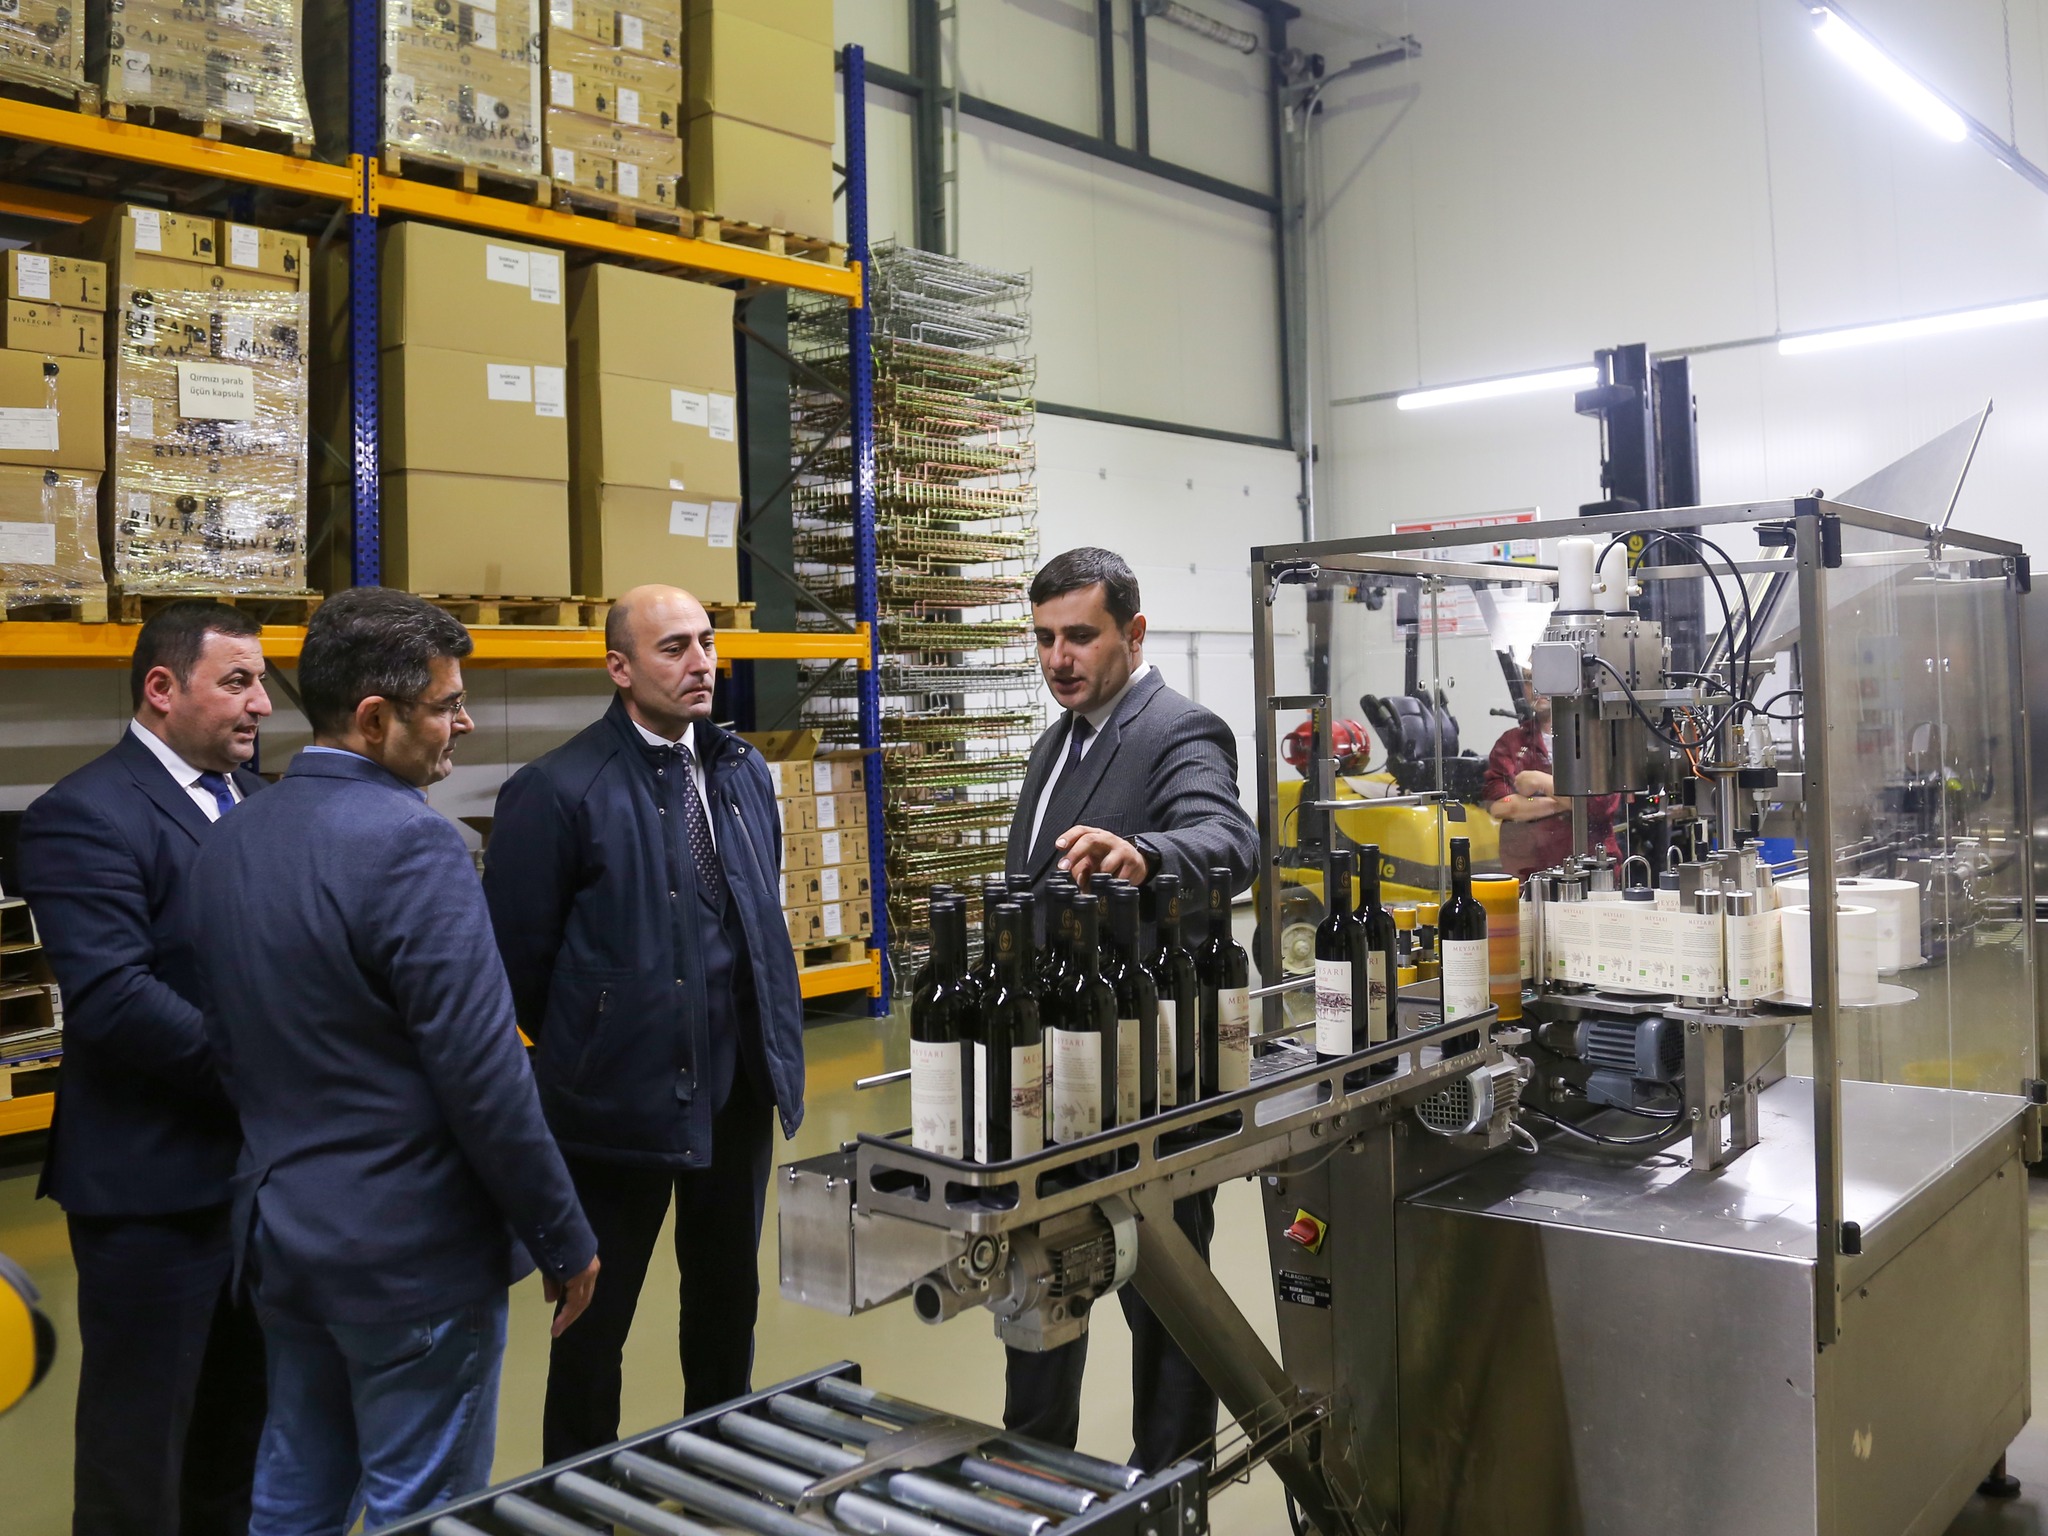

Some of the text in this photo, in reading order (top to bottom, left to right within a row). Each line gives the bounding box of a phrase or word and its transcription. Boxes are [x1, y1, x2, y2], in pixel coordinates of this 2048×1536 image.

[13, 316, 52, 326] RIVERCAP
[189, 373, 244, 386] Qırmızı şərab
[190, 386, 244, 399] üçün kapsula
